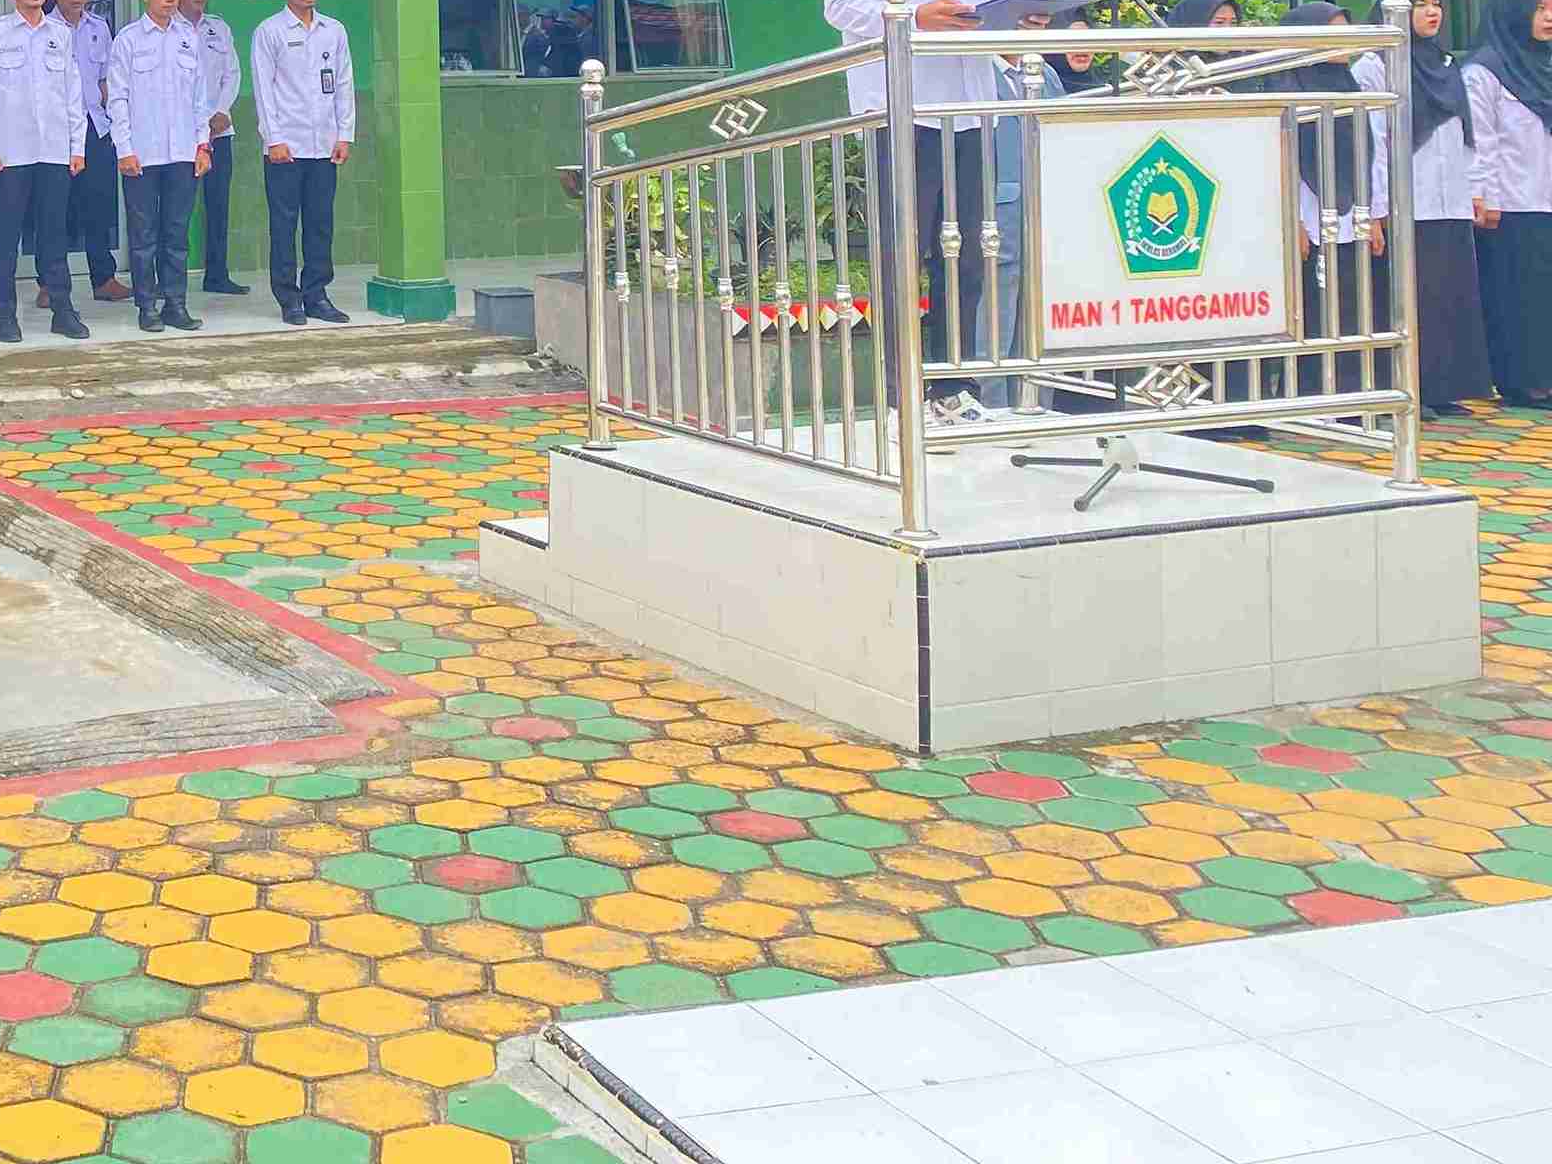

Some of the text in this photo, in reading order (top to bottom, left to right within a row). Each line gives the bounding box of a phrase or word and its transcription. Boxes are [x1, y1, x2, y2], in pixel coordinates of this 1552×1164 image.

[1050, 289, 1271, 330] MAN 1 TANGGAMUS
